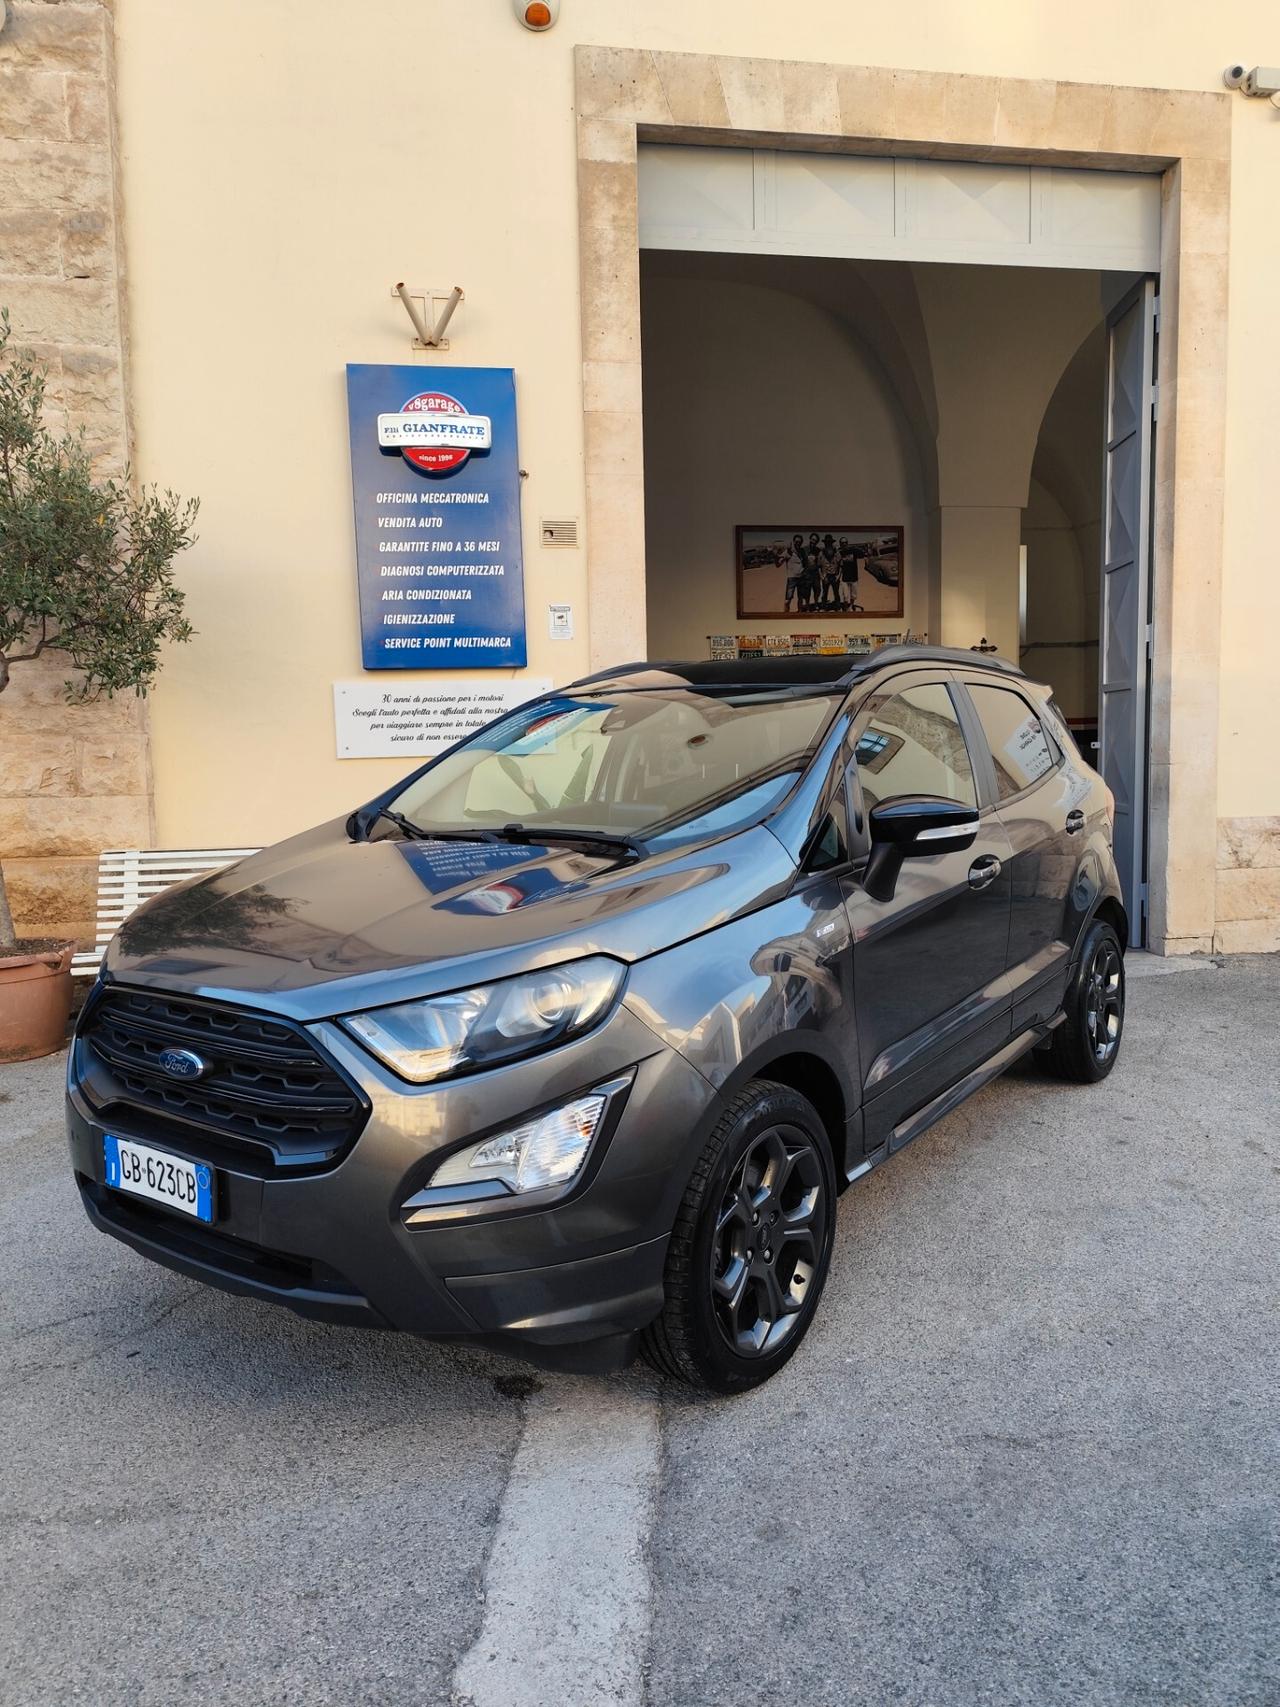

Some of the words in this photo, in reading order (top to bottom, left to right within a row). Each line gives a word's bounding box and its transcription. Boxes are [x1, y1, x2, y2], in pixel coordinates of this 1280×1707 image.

[403, 423, 485, 436] GIANFRATE
[419, 455, 436, 463] since
[376, 493, 418, 504] OFFICINA
[420, 493, 489, 504] MECCATRONICA
[378, 517, 416, 528] VENDITA
[418, 517, 443, 528] AUTO
[379, 541, 429, 552] GARANTITE
[431, 541, 453, 552] FINO
[455, 541, 461, 551] A
[463, 541, 476, 551] 36
[478, 541, 500, 551] MESI
[380, 566, 424, 577] DIAGNOSI
[426, 565, 505, 576] COMPUTERIZZATA
[382, 590, 404, 601] ARIA
[406, 589, 472, 600] CONDIZIONATA
[383, 613, 455, 625] IGIENIZZAZIONE
[384, 637, 421, 649] SERVICE
[423, 637, 452, 648] POINT
[453, 637, 512, 648] MULTIMARCA
[393, 694, 411, 703] anni
[413, 694, 421, 703] di
[422, 694, 456, 704] passione
[457, 695, 471, 704] per
[478, 693, 504, 702] motori
[352, 708, 377, 718] Scegli
[400, 707, 431, 718] perfetta
[439, 706, 467, 717] affidati
[468, 706, 483, 716] alla
[484, 706, 508, 715] nostra
[370, 722, 384, 731] per
[386, 720, 423, 730] viaggiare
[425, 721, 453, 731] sempre
[455, 719, 464, 728] in
[464, 719, 486, 728] totale
[391, 733, 414, 742] sicuro
[415, 732, 425, 741] di
[164, 1053, 190, 1074] Ford
